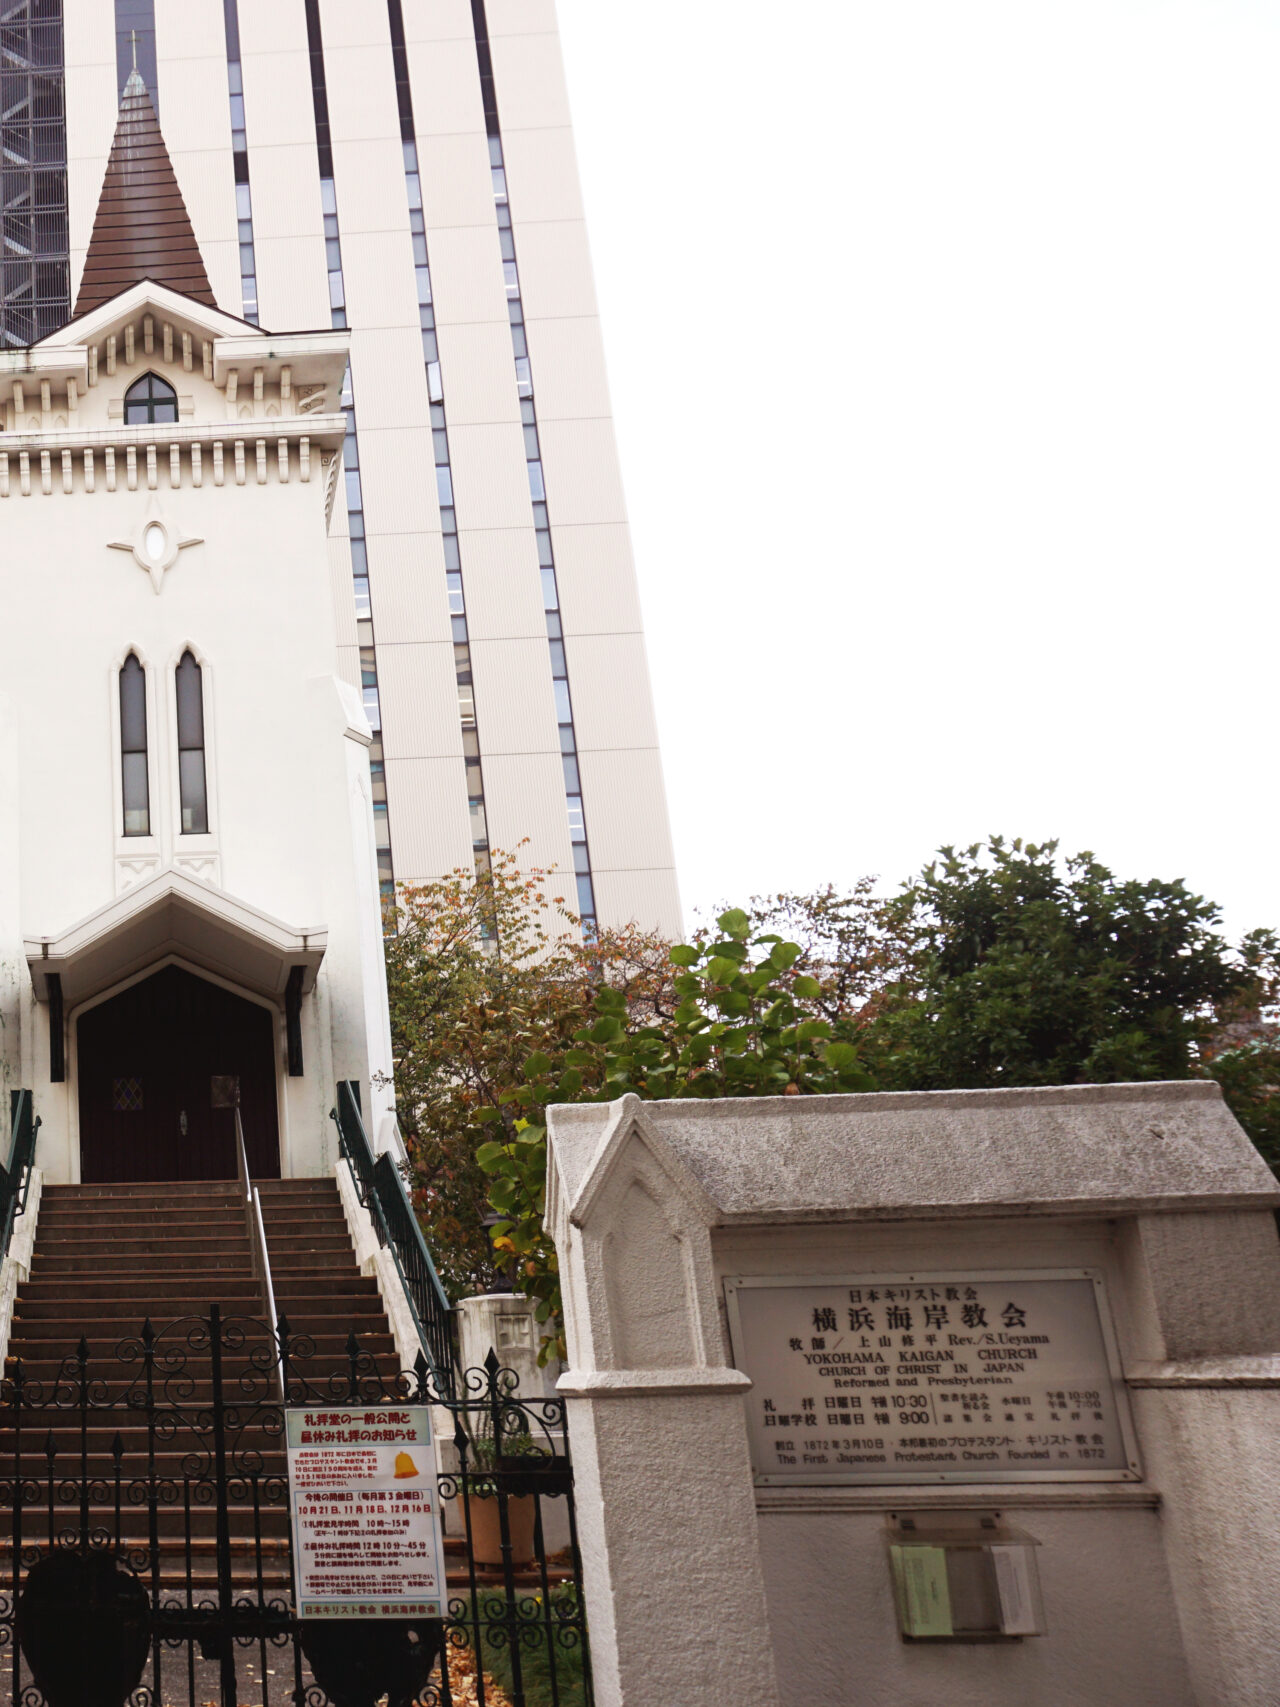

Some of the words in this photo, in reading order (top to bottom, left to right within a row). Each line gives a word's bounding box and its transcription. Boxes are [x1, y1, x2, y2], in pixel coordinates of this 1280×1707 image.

[848, 1286, 979, 1304] 日本キリスト教会
[812, 1302, 1028, 1333] 横浜海岸教会
[858, 1333, 938, 1349] 上山修平
[803, 1351, 885, 1366] YOKOHAMA
[898, 1350, 955, 1363] KAIGAN
[977, 1348, 1038, 1361] CHURCH
[818, 1365, 870, 1377] CHURCH
[874, 1364, 890, 1376] OF
[896, 1363, 942, 1376] CHRIST
[953, 1362, 969, 1374] IN
[982, 1361, 1025, 1374] JAPAN
[833, 1377, 891, 1389] Reformed
[895, 1376, 919, 1387] and
[927, 1375, 1014, 1389] Presbyterian
[824, 1395, 863, 1409] 日曜日
[890, 1394, 928, 1409] 10:30
[1001, 1396, 1032, 1407] 水曜日
[1068, 1390, 1101, 1401] 10:00
[304, 1412, 412, 1427] 礼拝堂の一般公開と
[764, 1413, 818, 1427] 日曜学校
[827, 1412, 865, 1426] 日曜日
[899, 1410, 929, 1426] 9:00
[300, 1428, 418, 1444] 昼休み礼拝のお知らせ
[774, 1440, 796, 1451] 創立
[777, 1453, 797, 1466] The
[803, 1453, 829, 1465] First
[836, 1451, 887, 1466] Japanese
[894, 1450, 958, 1464] Protestant
[962, 1450, 1000, 1462] Church
[1007, 1448, 1051, 1461] Founded
[1058, 1449, 1070, 1460] in
[1076, 1448, 1106, 1460] 1872
[304, 1605, 377, 1615] 日本キリスト教会
[381, 1604, 437, 1614] 横浜海岸教会
